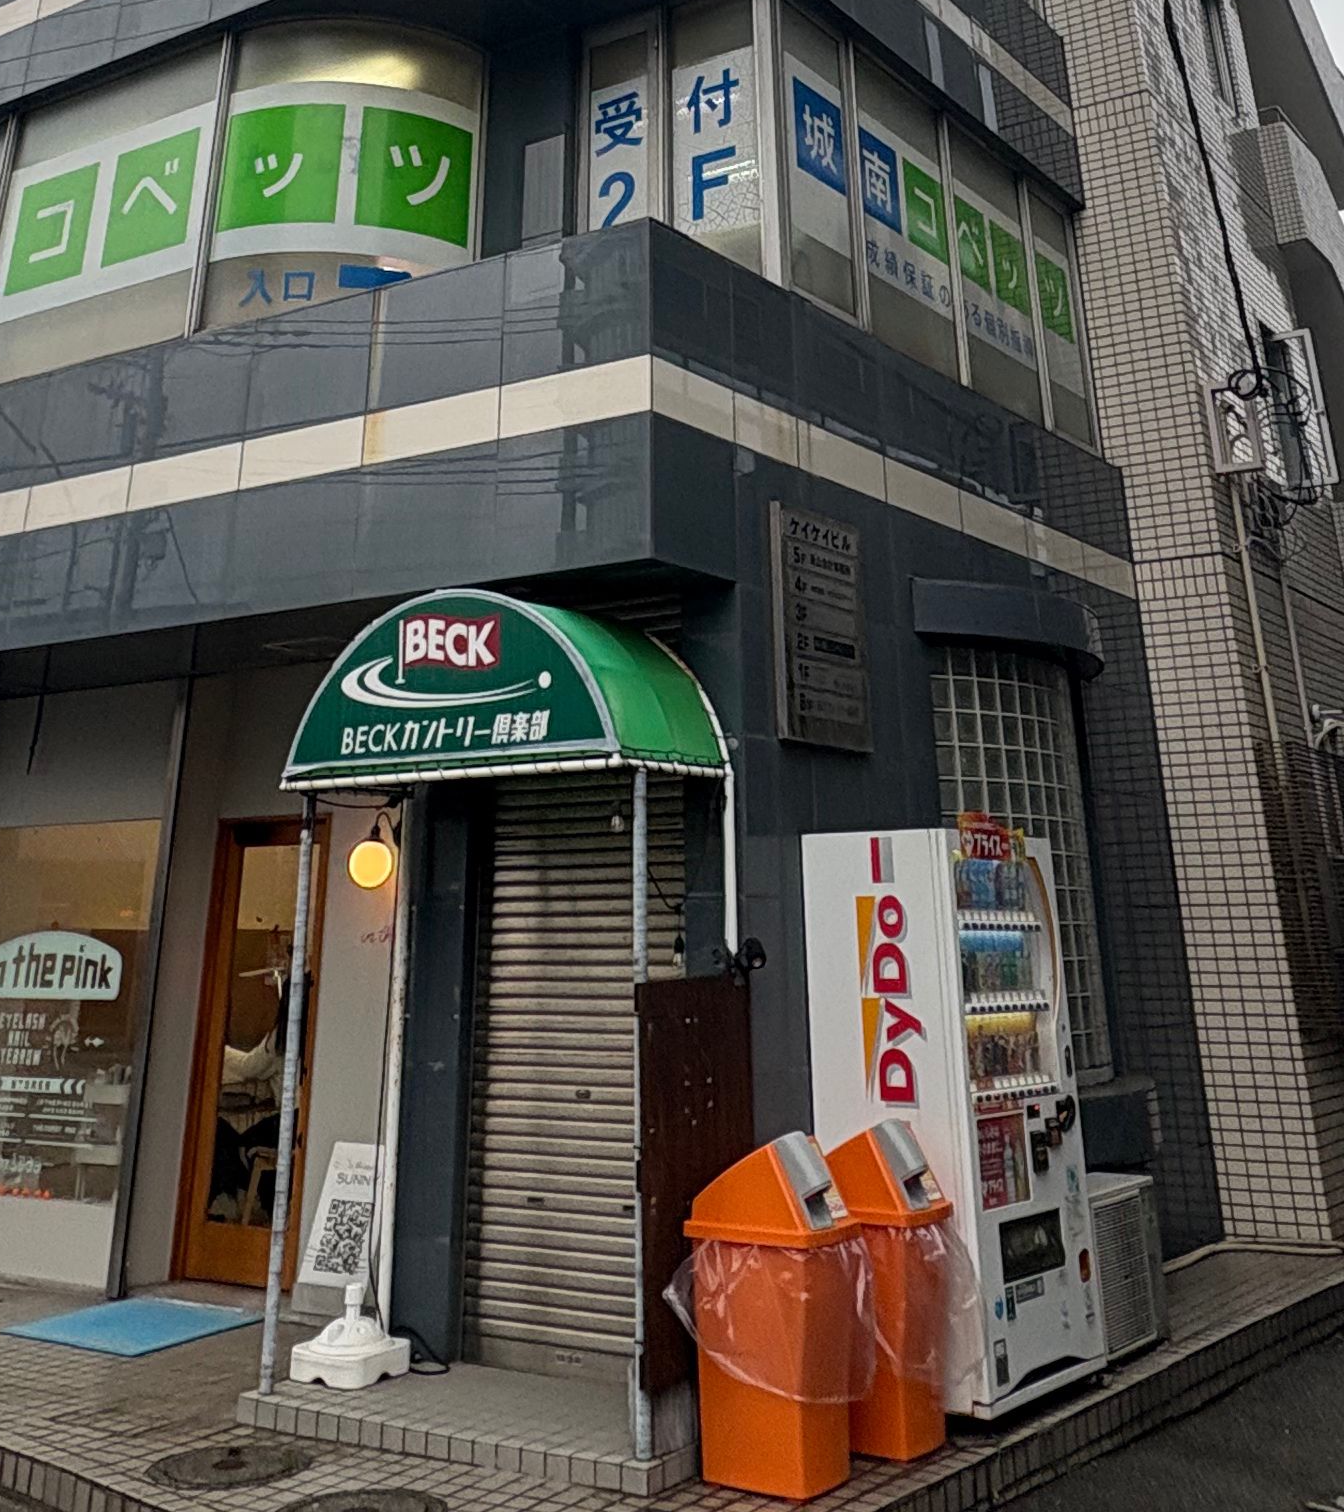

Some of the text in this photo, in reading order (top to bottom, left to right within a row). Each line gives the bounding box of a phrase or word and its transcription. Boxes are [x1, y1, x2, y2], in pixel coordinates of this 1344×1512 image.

[594, 67, 741, 158] 受付
[28, 143, 451, 265] コベッツ
[597, 145, 740, 228] 2F
[801, 100, 1064, 318] 城南コベッツ
[238, 269, 316, 307] 入口
[404, 618, 496, 668] BECK
[340, 709, 551, 755] BECKカントリー倶楽部
[12, 942, 58, 989] the
[872, 894, 924, 1104] DyDo
[7, 1030, 31, 1047] NAIL
